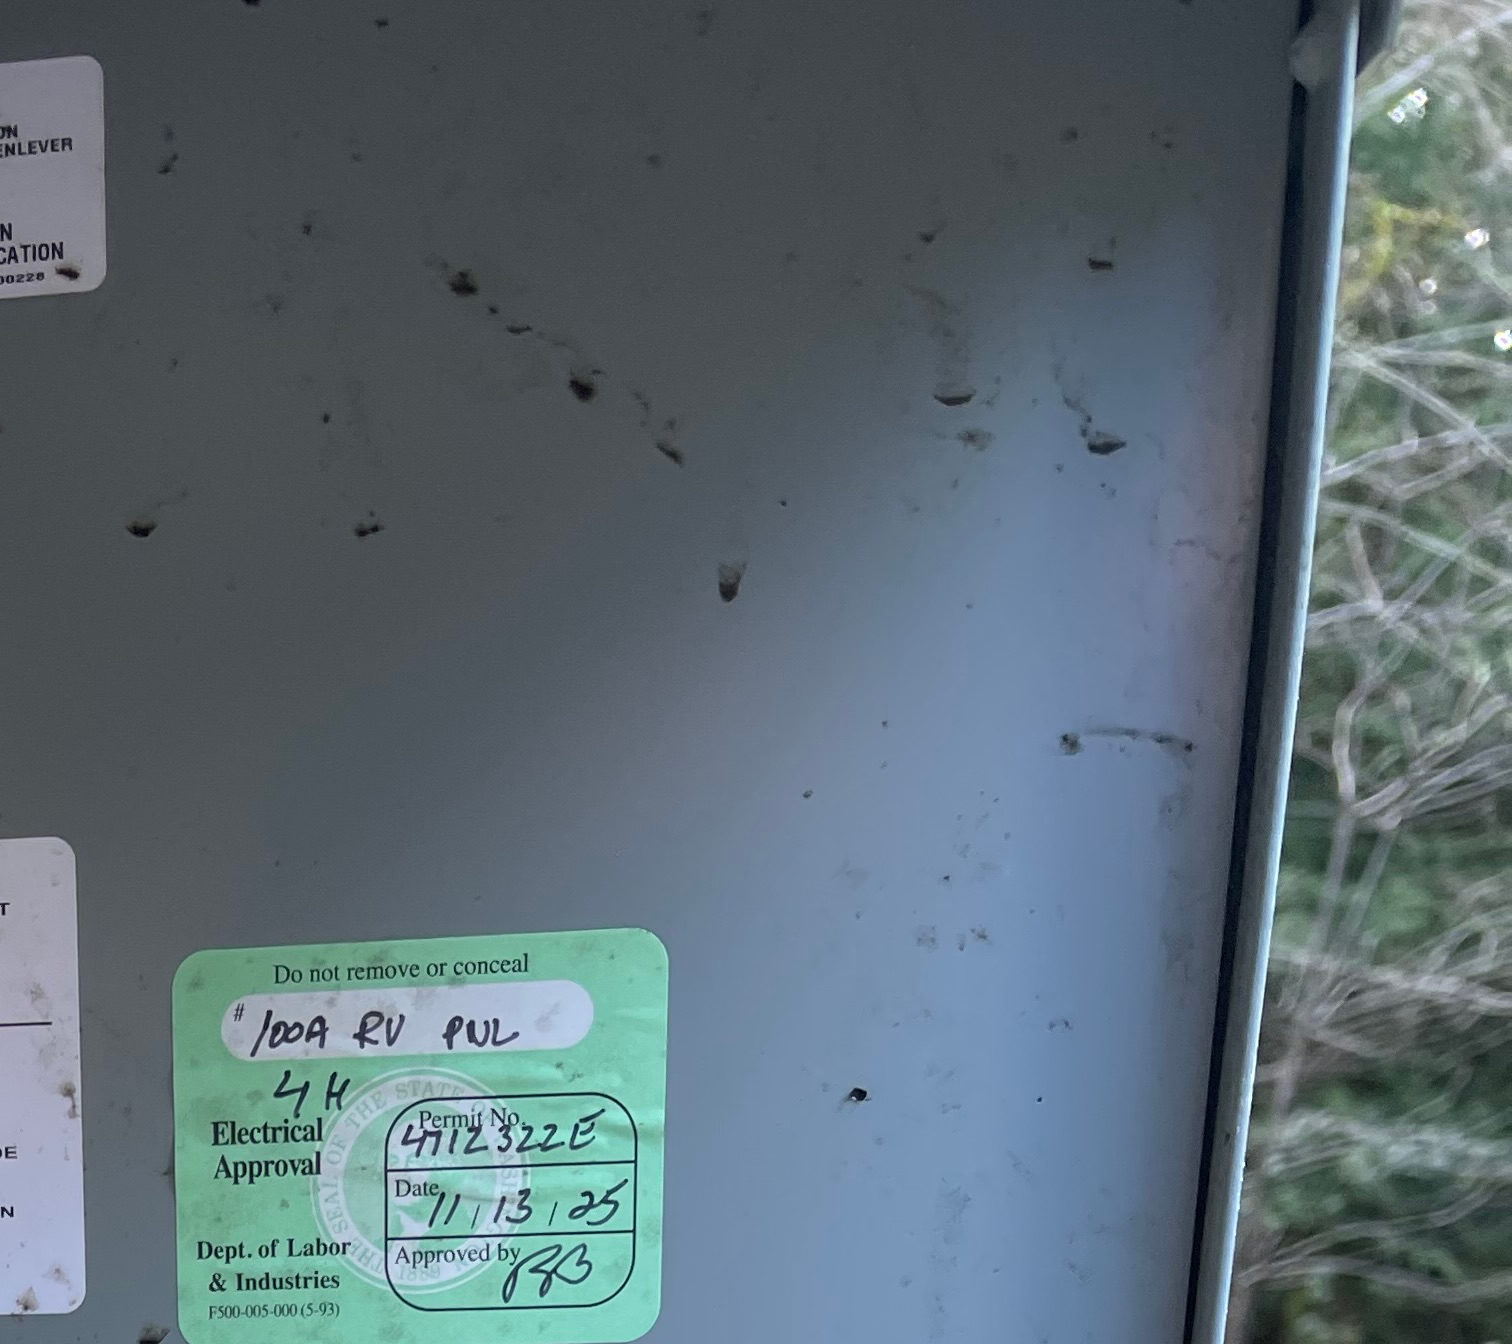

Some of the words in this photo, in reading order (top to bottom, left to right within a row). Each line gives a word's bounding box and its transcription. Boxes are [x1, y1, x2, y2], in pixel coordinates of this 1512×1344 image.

[273, 964, 303, 984] Do
[310, 964, 339, 983] not
[347, 963, 420, 981] remove
[426, 961, 448, 978] or
[453, 953, 529, 976] conceal
[353, 1010, 405, 1050] RV
[211, 1117, 324, 1147] Electrical
[418, 1109, 483, 1130] Permit
[490, 1108, 527, 1126] No.
[213, 1151, 322, 1185] Approval
[394, 1179, 440, 1198] Date
[197, 1240, 252, 1264] Dept.
[258, 1238, 280, 1258] of
[286, 1238, 352, 1258] Labor
[394, 1243, 490, 1270] Approved
[497, 1246, 521, 1266] by
[208, 1272, 228, 1292] &
[236, 1271, 341, 1292] Industries
[300, 1302, 341, 1319] (5-93)
